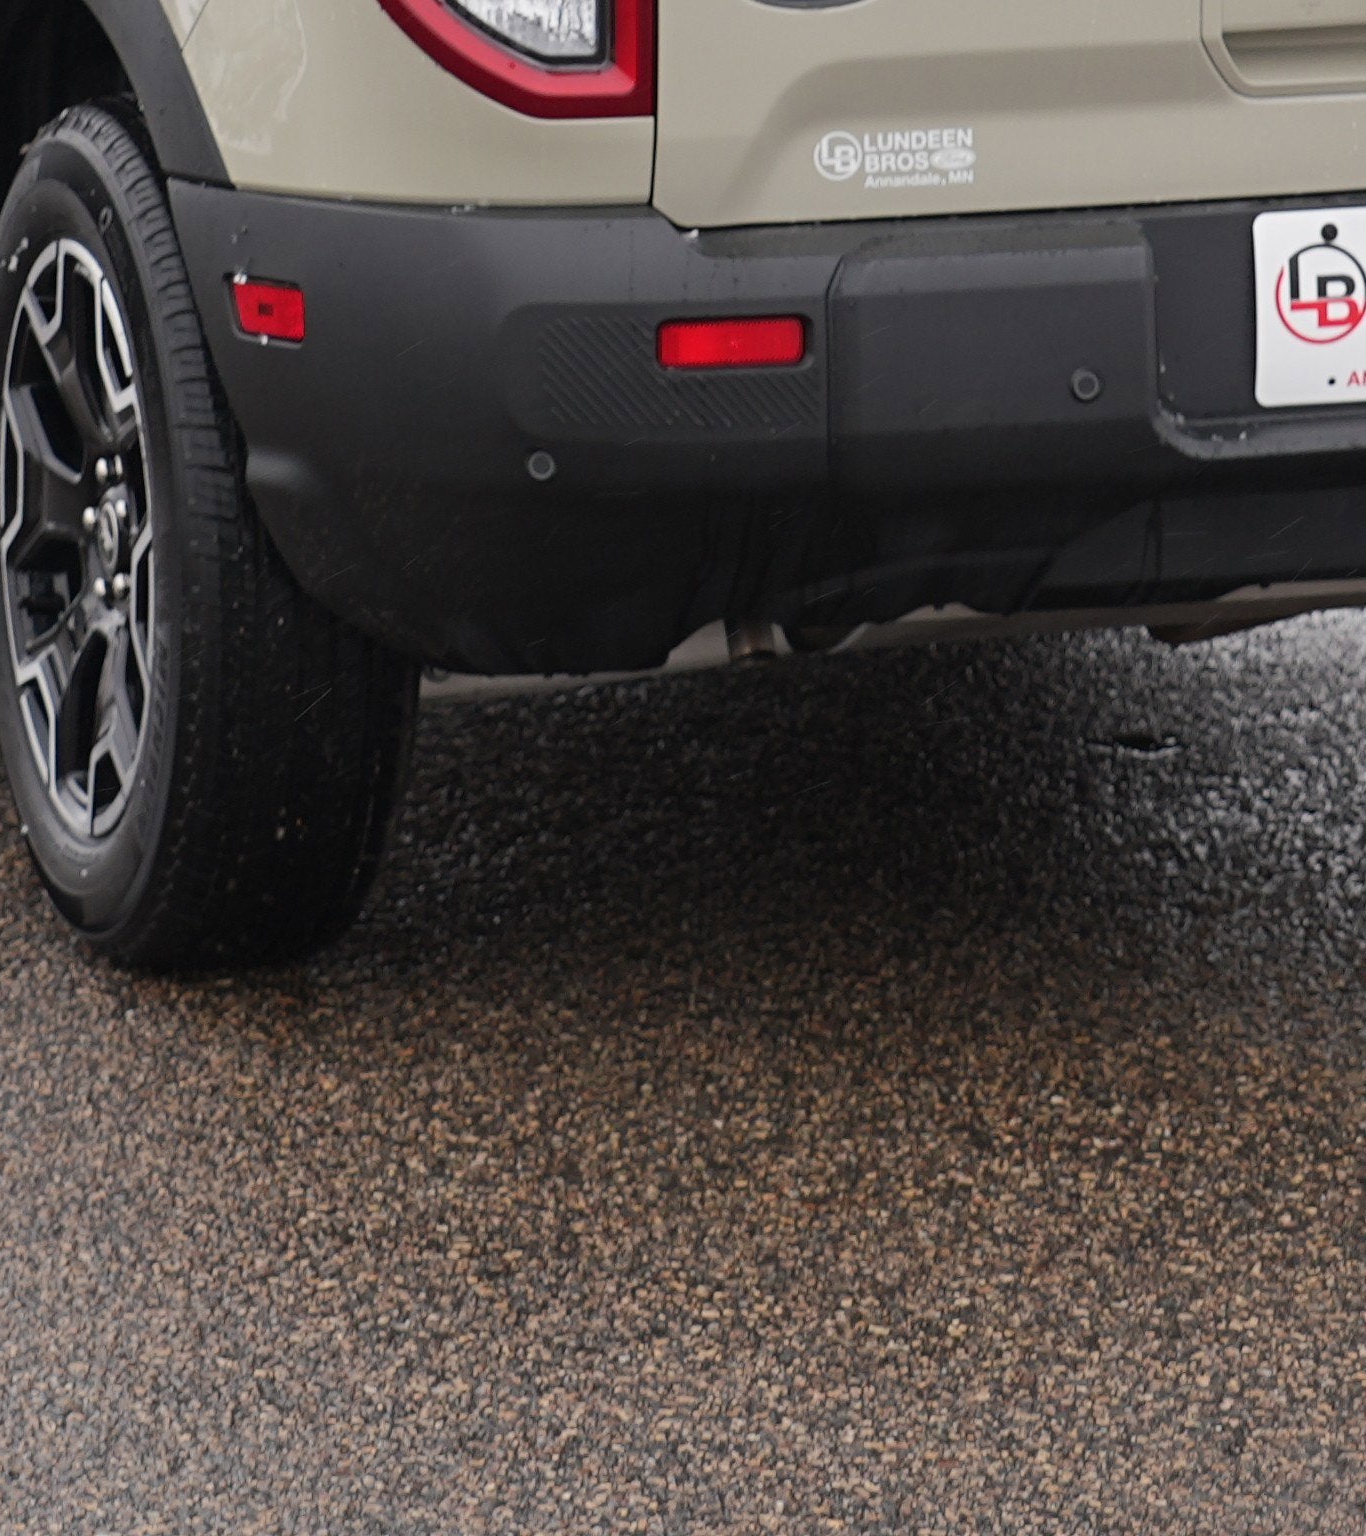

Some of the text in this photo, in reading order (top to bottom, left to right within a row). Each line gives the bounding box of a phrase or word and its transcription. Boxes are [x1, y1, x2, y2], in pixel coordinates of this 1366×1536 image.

[863, 128, 973, 152] LUNDEEN
[864, 151, 929, 174] BROS
[948, 169, 974, 185] MN
